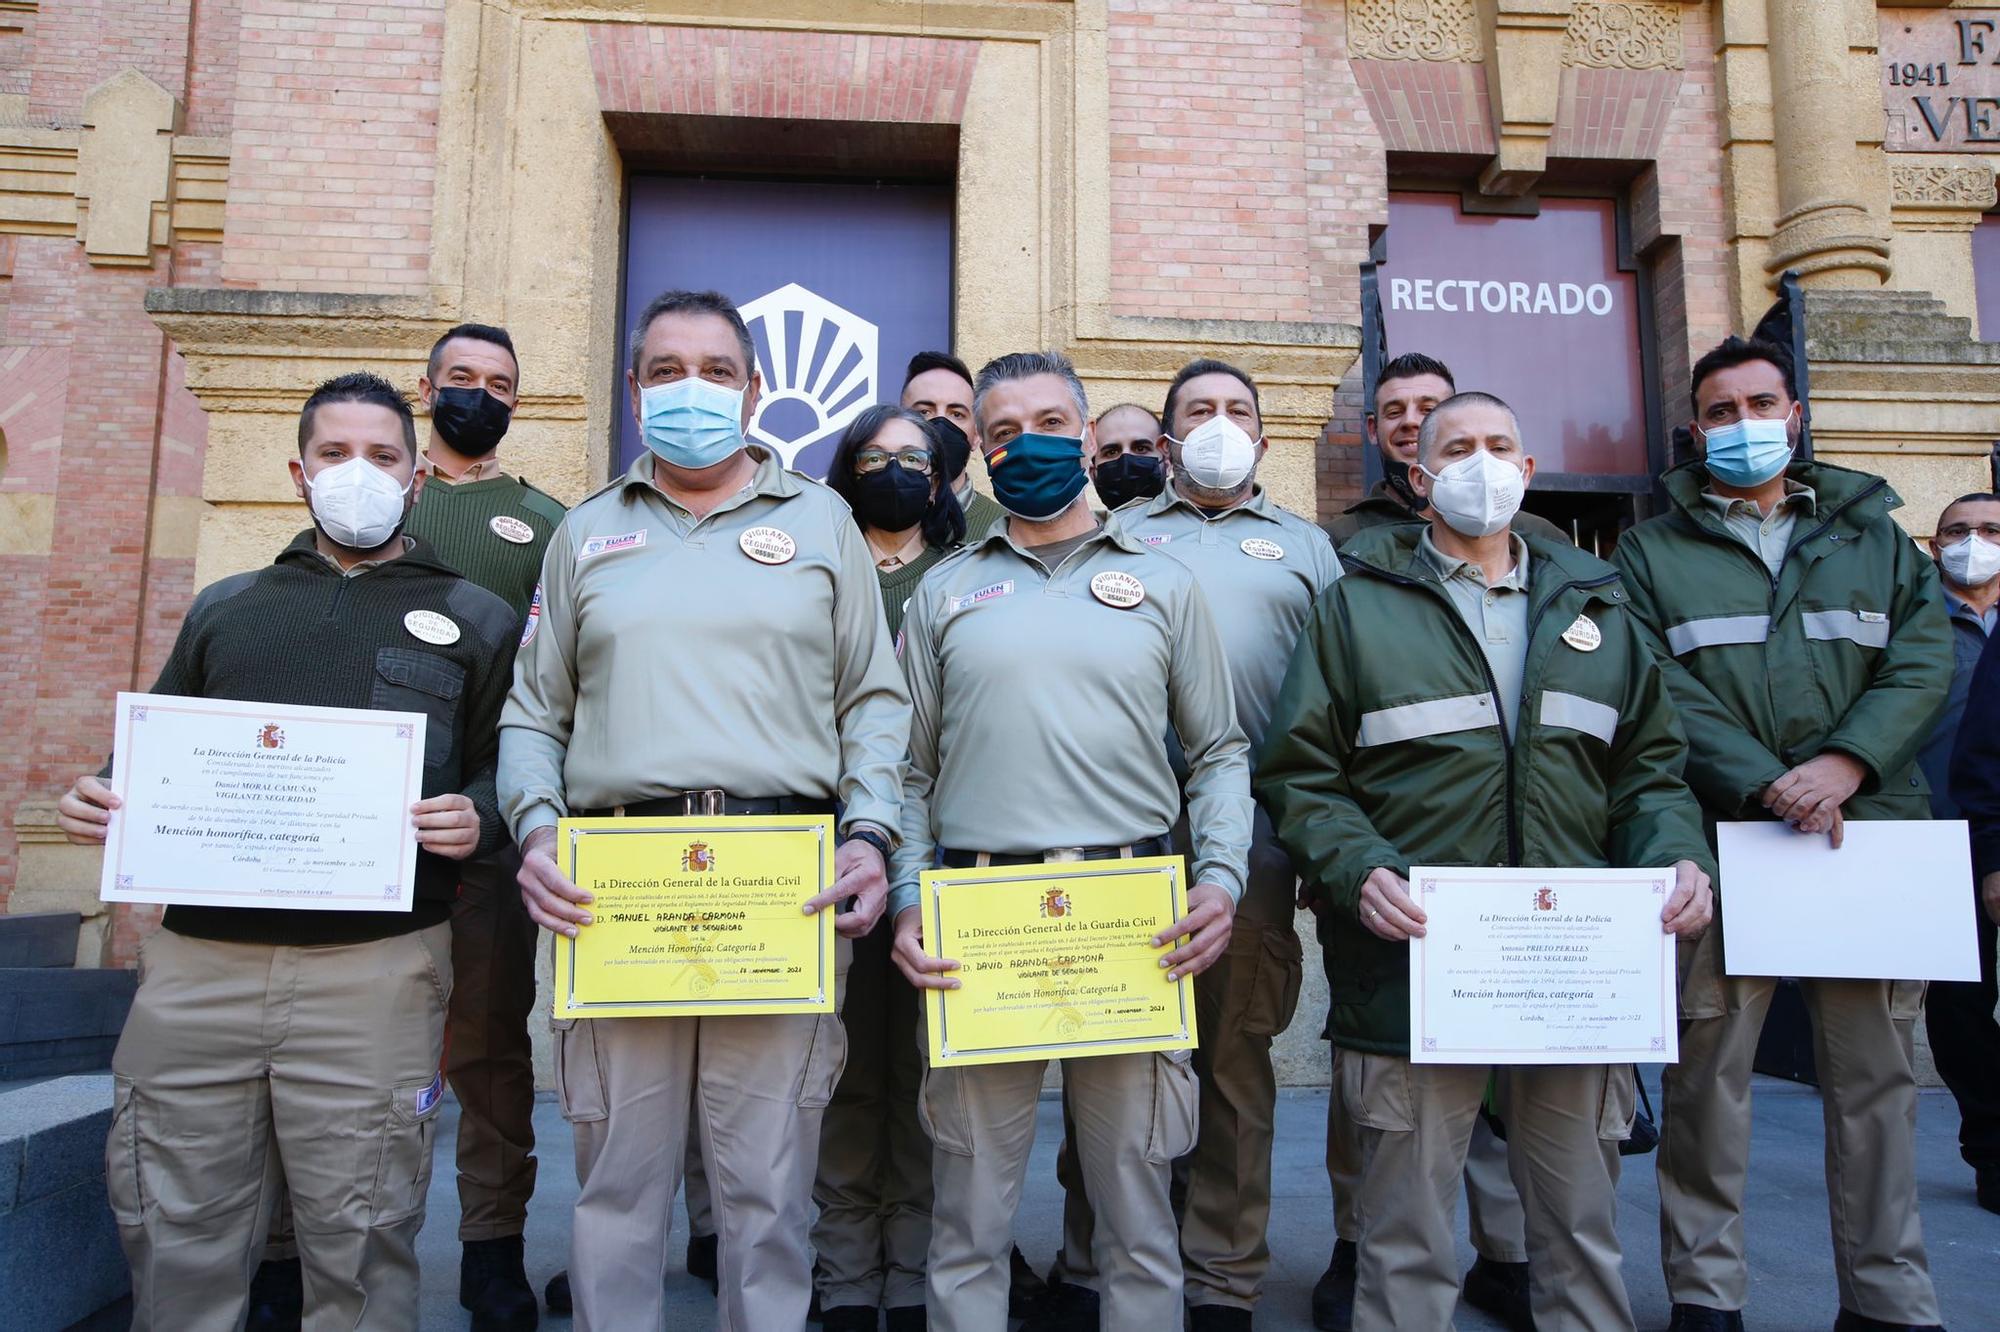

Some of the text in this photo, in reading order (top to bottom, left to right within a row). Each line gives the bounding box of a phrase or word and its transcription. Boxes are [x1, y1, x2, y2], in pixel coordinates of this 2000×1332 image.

[1954, 20, 2000, 65] F
[1889, 62, 1950, 87] 1941
[1391, 278, 1613, 315] RECTORADO
[606, 534, 637, 546] EULEN
[745, 528, 792, 546] VIGILANTE
[743, 537, 791, 555] SEGURIDAD
[1095, 573, 1140, 590] VIGILANTE
[974, 584, 1004, 599] EULEN
[1094, 583, 1141, 598] SEGURIDAD
[407, 619, 458, 639] SEGURIDAD
[194, 748, 346, 764] La Dirección General de la Policía
[162, 777, 317, 793] D. Daniel MORAL CAMUÑAS
[215, 791, 316, 803] VIGILANTE SEGURIDAD
[154, 825, 204, 836] Mención
[206, 827, 268, 842] honorífica,
[269, 831, 320, 844] categoría
[594, 876, 800, 889] La Dirección General de la Guardia Civil
[610, 913, 650, 922] MANUEL
[656, 912, 695, 921] ARANDA
[702, 911, 746, 921] CARMONA
[958, 916, 1156, 939] La Dirección General de la Guardia Civil
[629, 944, 665, 953] Mención
[716, 943, 756, 954] Categoría
[759, 942, 766, 951] B
[1009, 957, 1049, 968] ARANDA
[1057, 953, 1105, 965] CARMONA
[996, 990, 1031, 1000] Mención
[1080, 984, 1119, 997] Categoría
[1121, 983, 1128, 991] B
[1451, 989, 1494, 998] Mención
[1496, 989, 1548, 1000] honorífica,
[1550, 990, 1594, 1000] categoría
